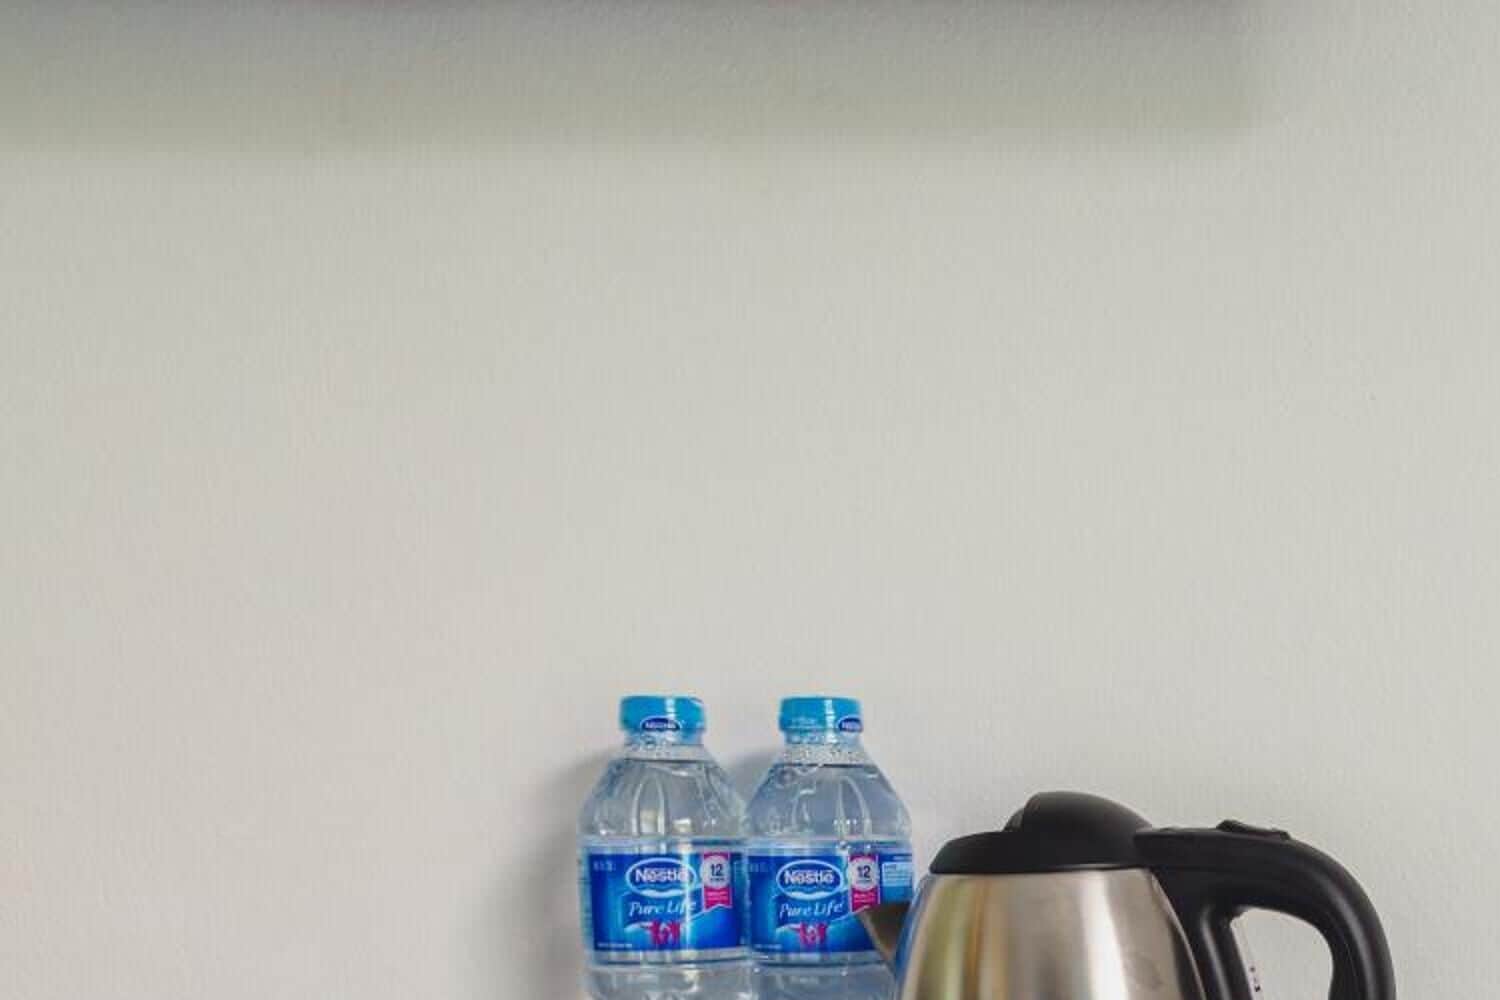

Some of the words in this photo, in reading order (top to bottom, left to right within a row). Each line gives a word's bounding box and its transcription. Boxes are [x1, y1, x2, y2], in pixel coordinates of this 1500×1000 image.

[710, 863, 723, 877] 12
[857, 865, 871, 879] 12
[628, 901, 664, 917] Pure
[666, 899, 697, 915] Life
[779, 903, 812, 919] Pure
[814, 901, 844, 917] Life
